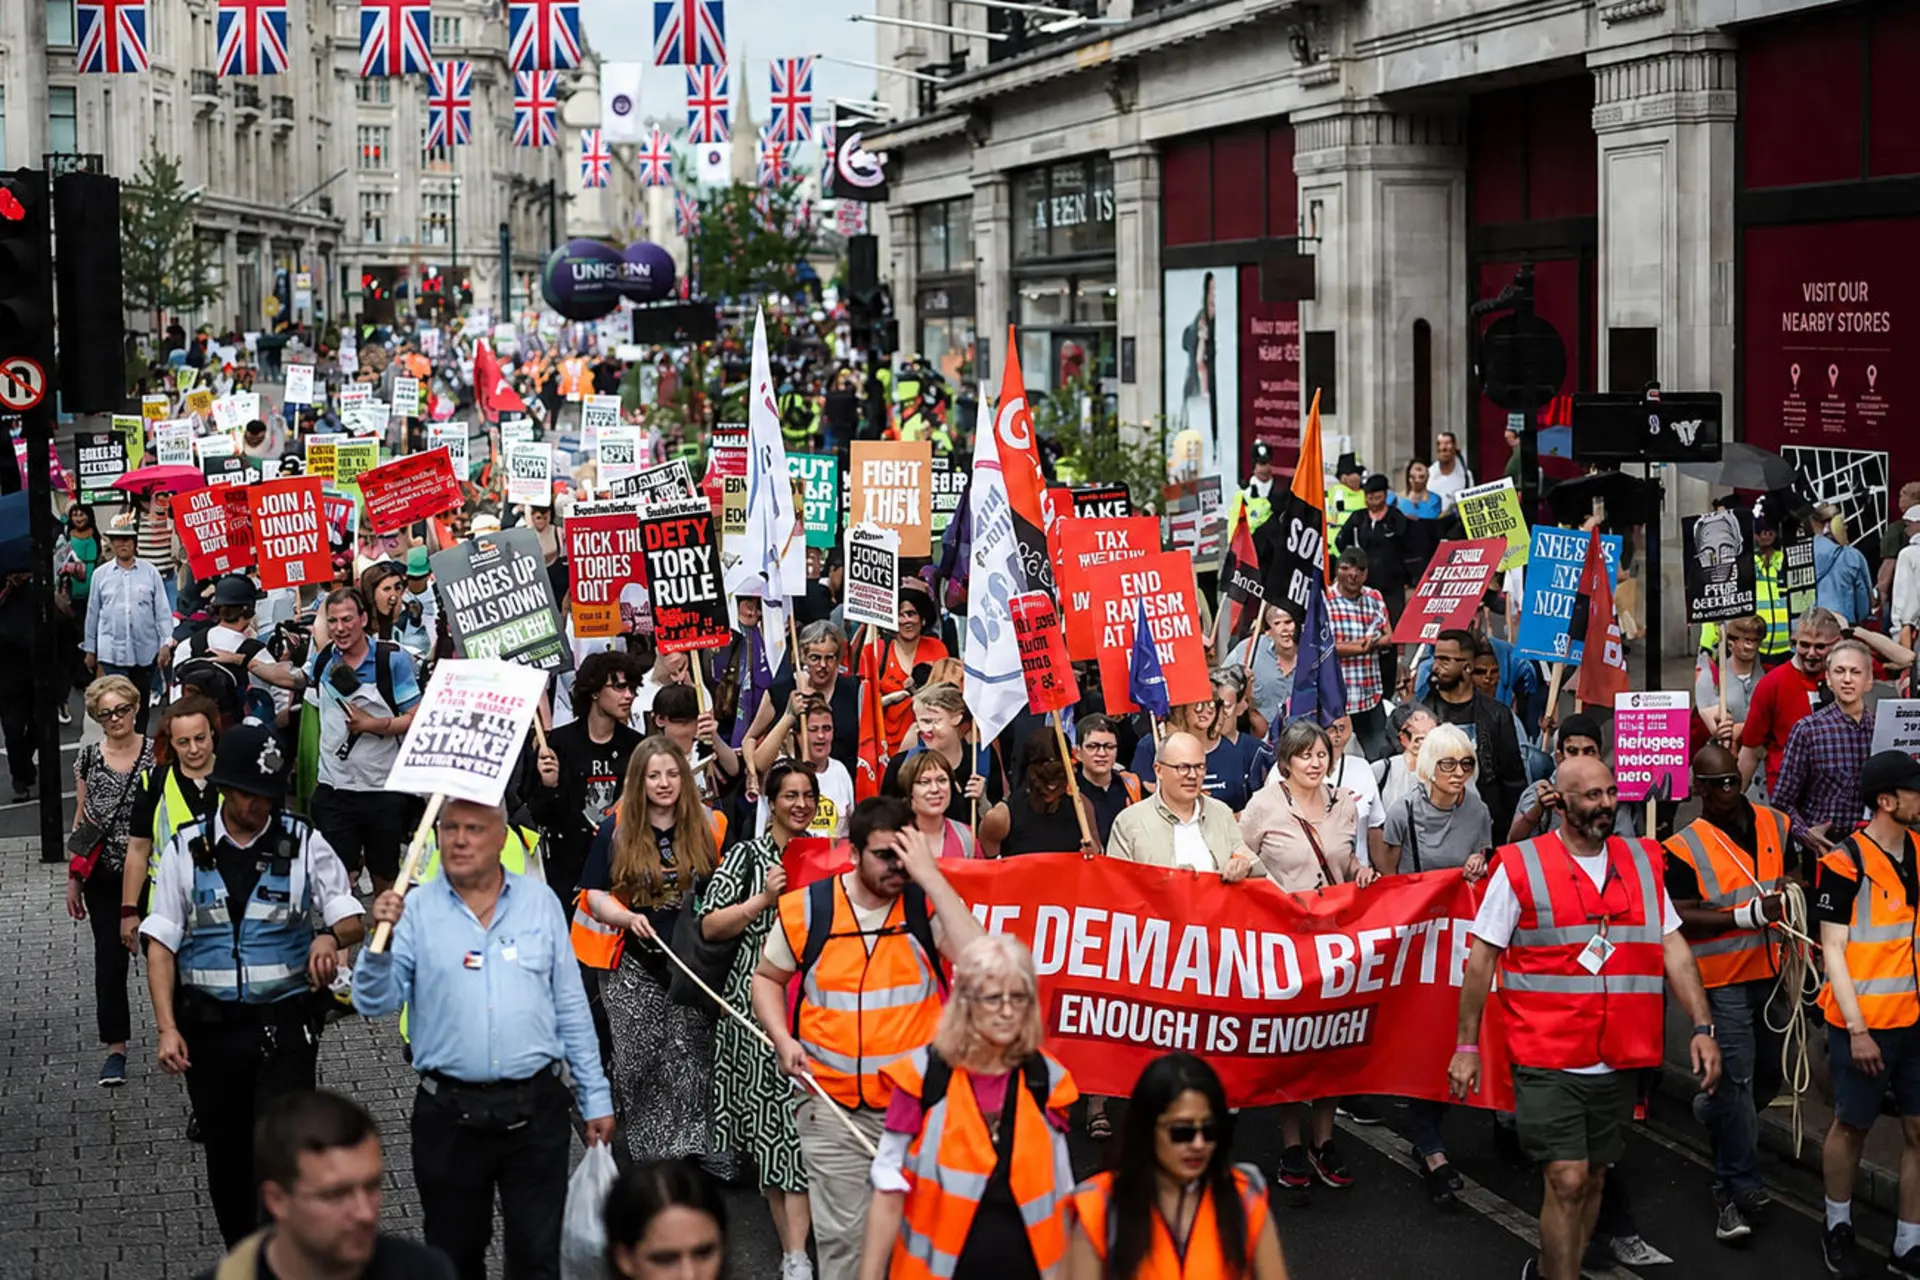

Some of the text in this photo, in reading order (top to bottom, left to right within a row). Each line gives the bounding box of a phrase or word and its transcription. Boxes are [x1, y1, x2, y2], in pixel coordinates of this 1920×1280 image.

[1802, 281, 1869, 302] VISIT OUR
[1782, 311, 1890, 332] NEARBY STORES
[862, 460, 923, 488] FIGHT
[257, 490, 316, 517] JOIN A
[259, 510, 318, 538] UNION
[644, 517, 709, 550] DEFY
[262, 532, 320, 560] TODAY
[573, 530, 613, 556] KICK
[1094, 530, 1130, 550] TAX
[574, 554, 632, 579] TORIES
[647, 545, 712, 579] TORY
[445, 564, 514, 610] WAGES
[511, 555, 538, 584] UP
[653, 573, 718, 607] RULE
[1120, 570, 1161, 597] END
[455, 601, 500, 635] BILLS
[498, 581, 549, 619] DOWN
[1103, 624, 1126, 648] AT
[411, 726, 511, 763] STRIKE
[1032, 904, 1304, 1001] DEMAND
[1313, 916, 1498, 999] BETTE
[1057, 994, 1370, 1055] ENOUGH IS ENOUGH
